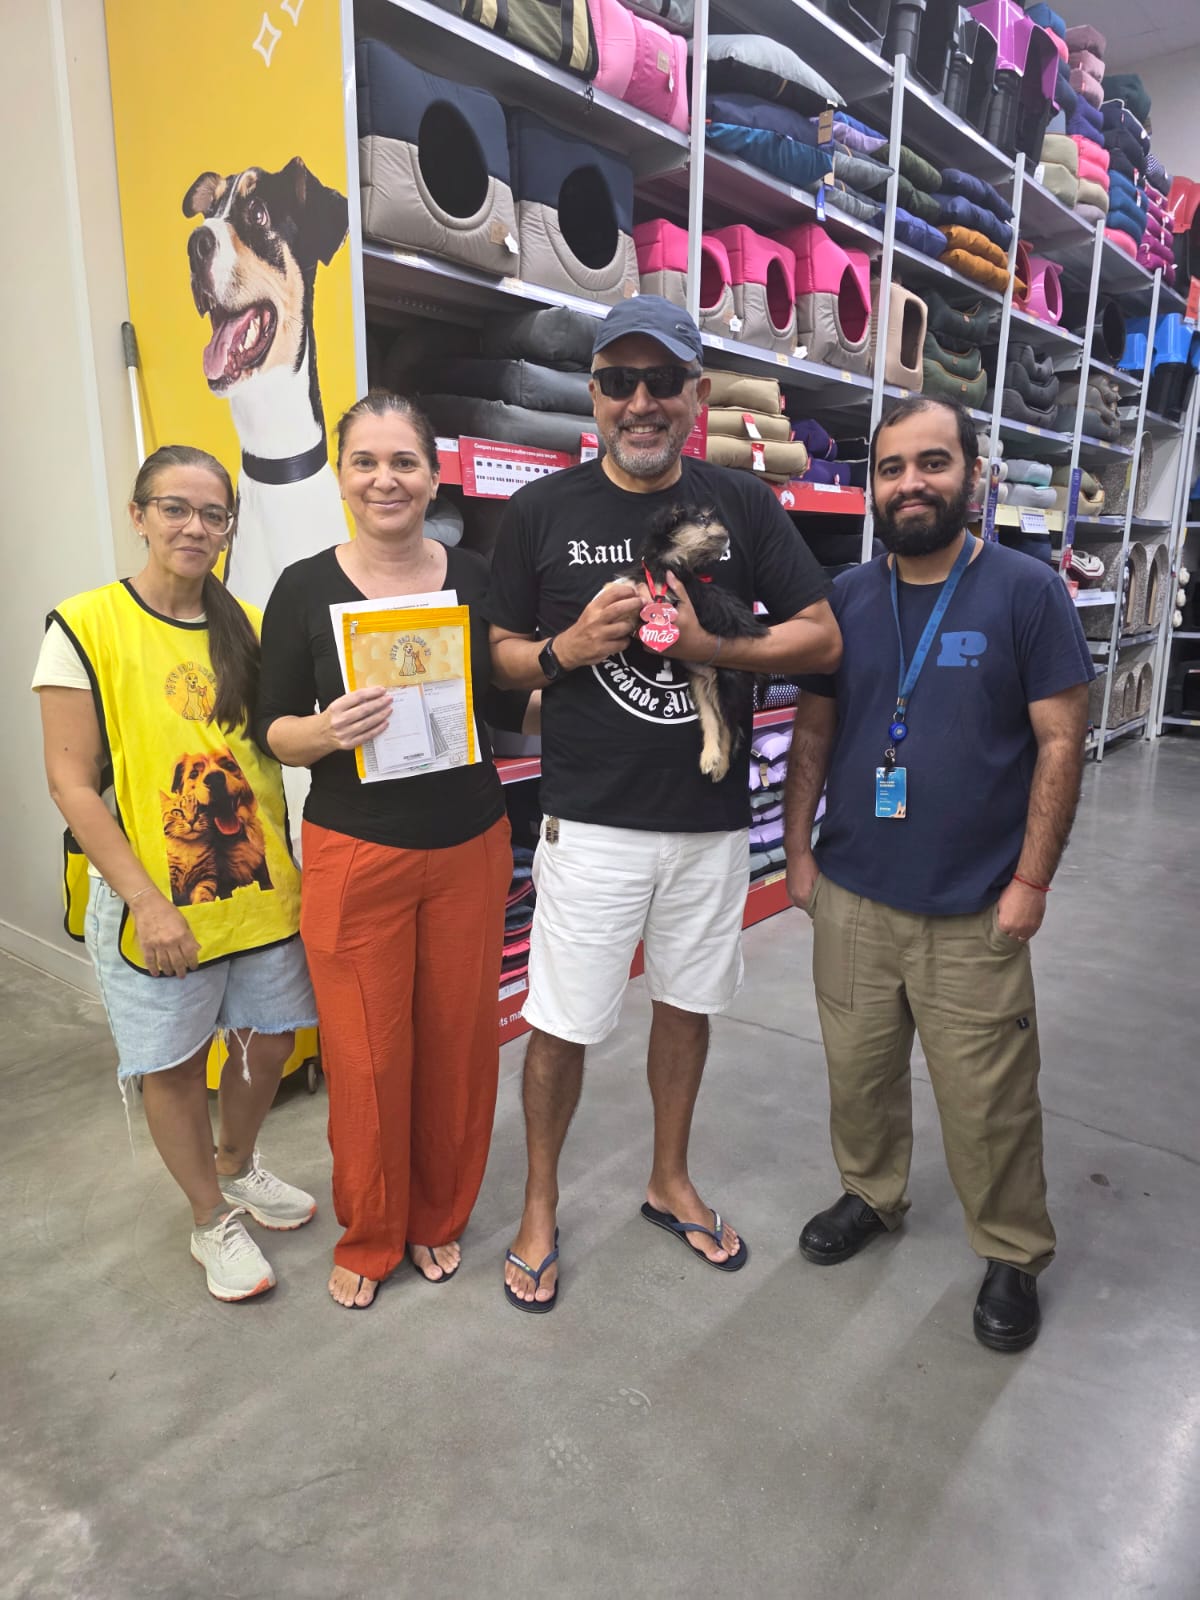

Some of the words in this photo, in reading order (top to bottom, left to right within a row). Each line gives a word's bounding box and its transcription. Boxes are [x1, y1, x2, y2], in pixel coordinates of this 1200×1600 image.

[567, 538, 634, 566] Raul
[602, 655, 659, 711] ciedade
[499, 1017, 508, 1027] ts
